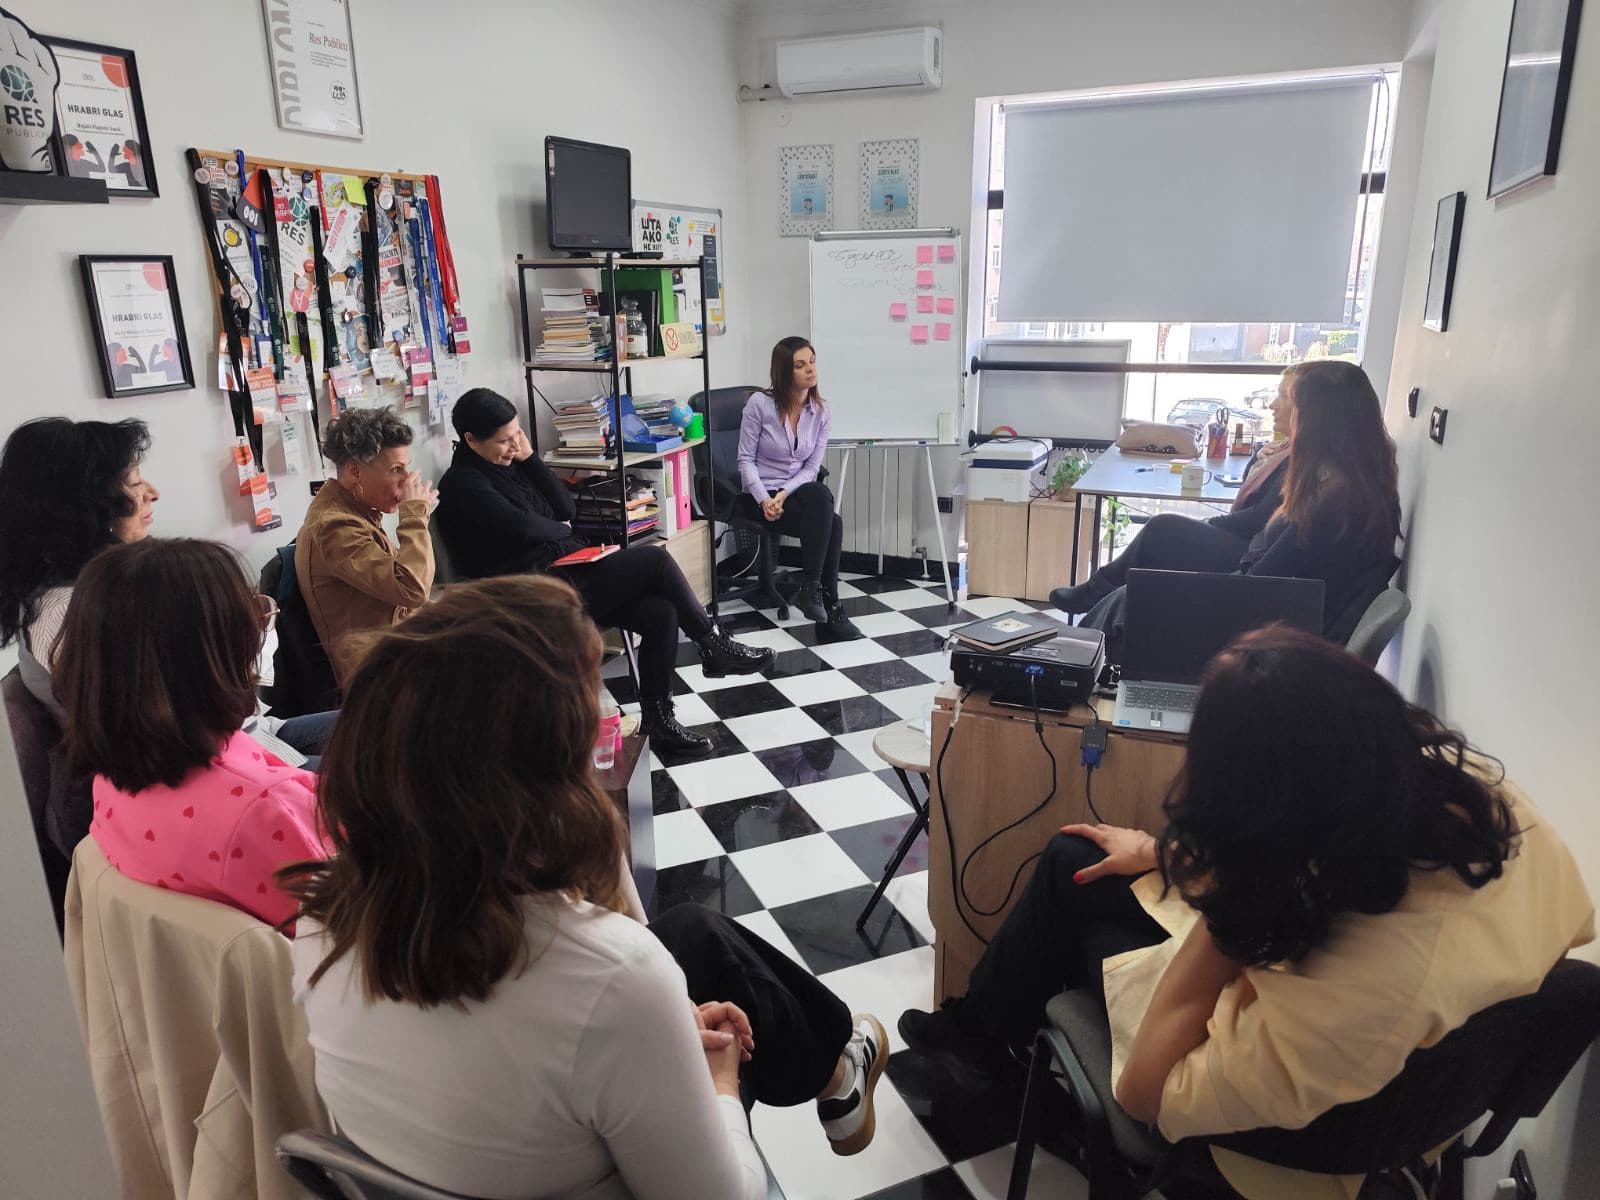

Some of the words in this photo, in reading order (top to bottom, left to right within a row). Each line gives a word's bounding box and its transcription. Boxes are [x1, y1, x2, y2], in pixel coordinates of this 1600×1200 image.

[309, 32, 322, 45] Res
[4, 104, 45, 128] RES
[67, 104, 101, 115] HRABRI
[102, 108, 124, 118] GLAS
[641, 217, 662, 231] ШТА
[281, 221, 305, 246] RES
[642, 231, 662, 242] АКО
[111, 313, 142, 322] HRABRI
[143, 312, 163, 321] GLAS
